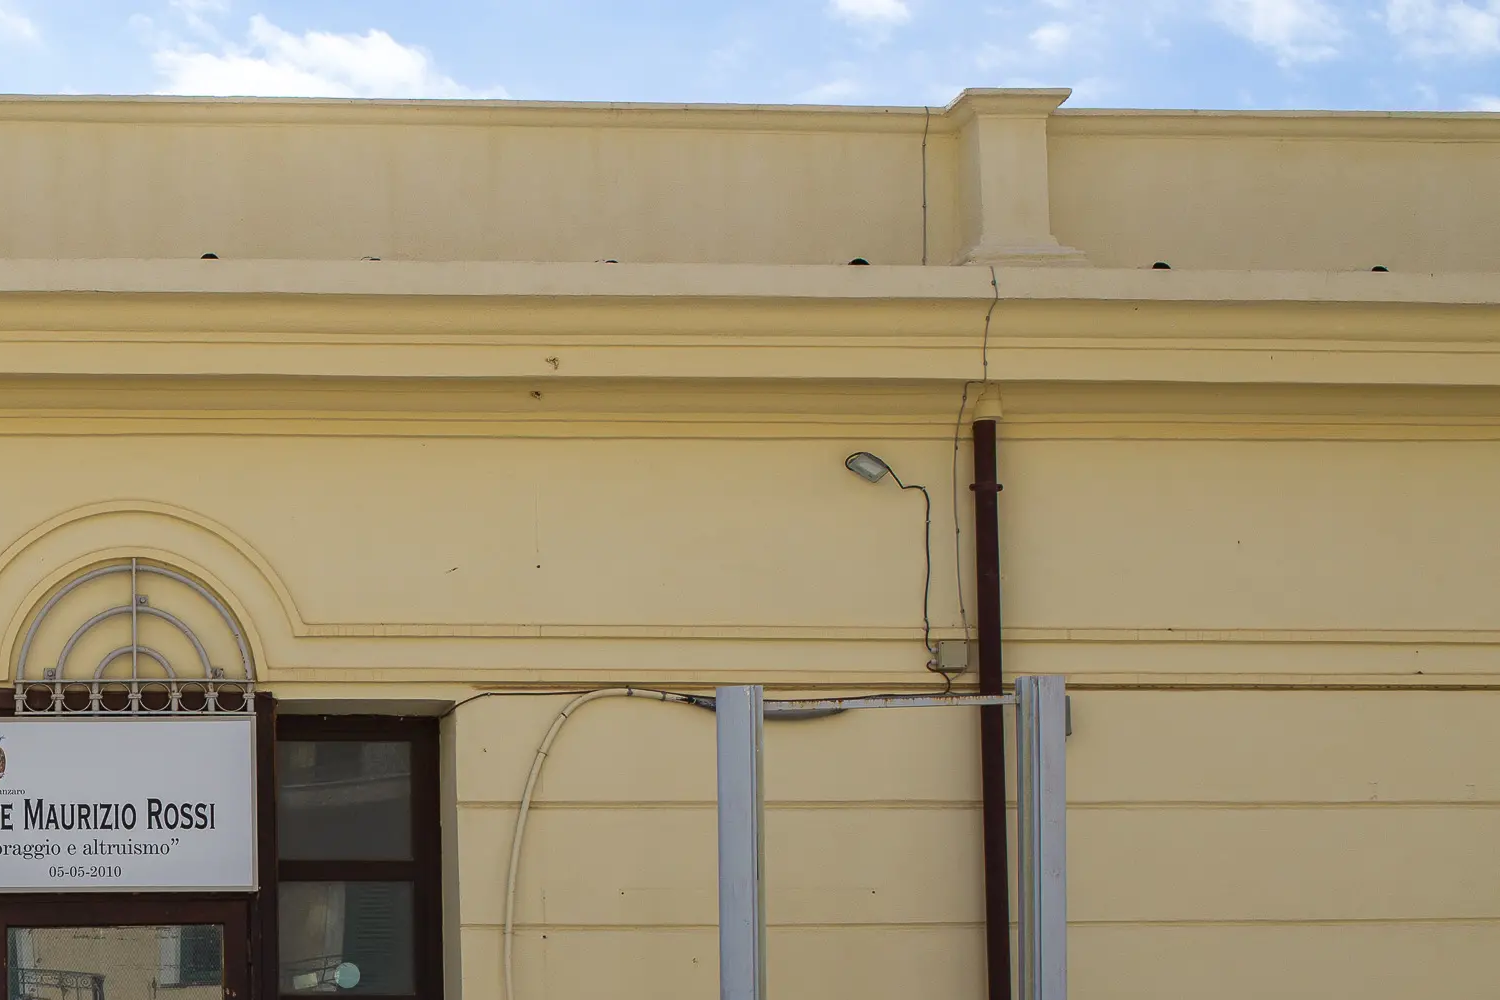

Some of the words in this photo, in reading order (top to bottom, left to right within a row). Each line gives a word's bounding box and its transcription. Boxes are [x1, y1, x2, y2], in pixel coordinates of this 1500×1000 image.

[23, 799, 137, 831] MAURIZIO
[146, 799, 216, 830] ROSSI
[66, 844, 77, 856] e
[48, 865, 122, 878] 05-05-2010
